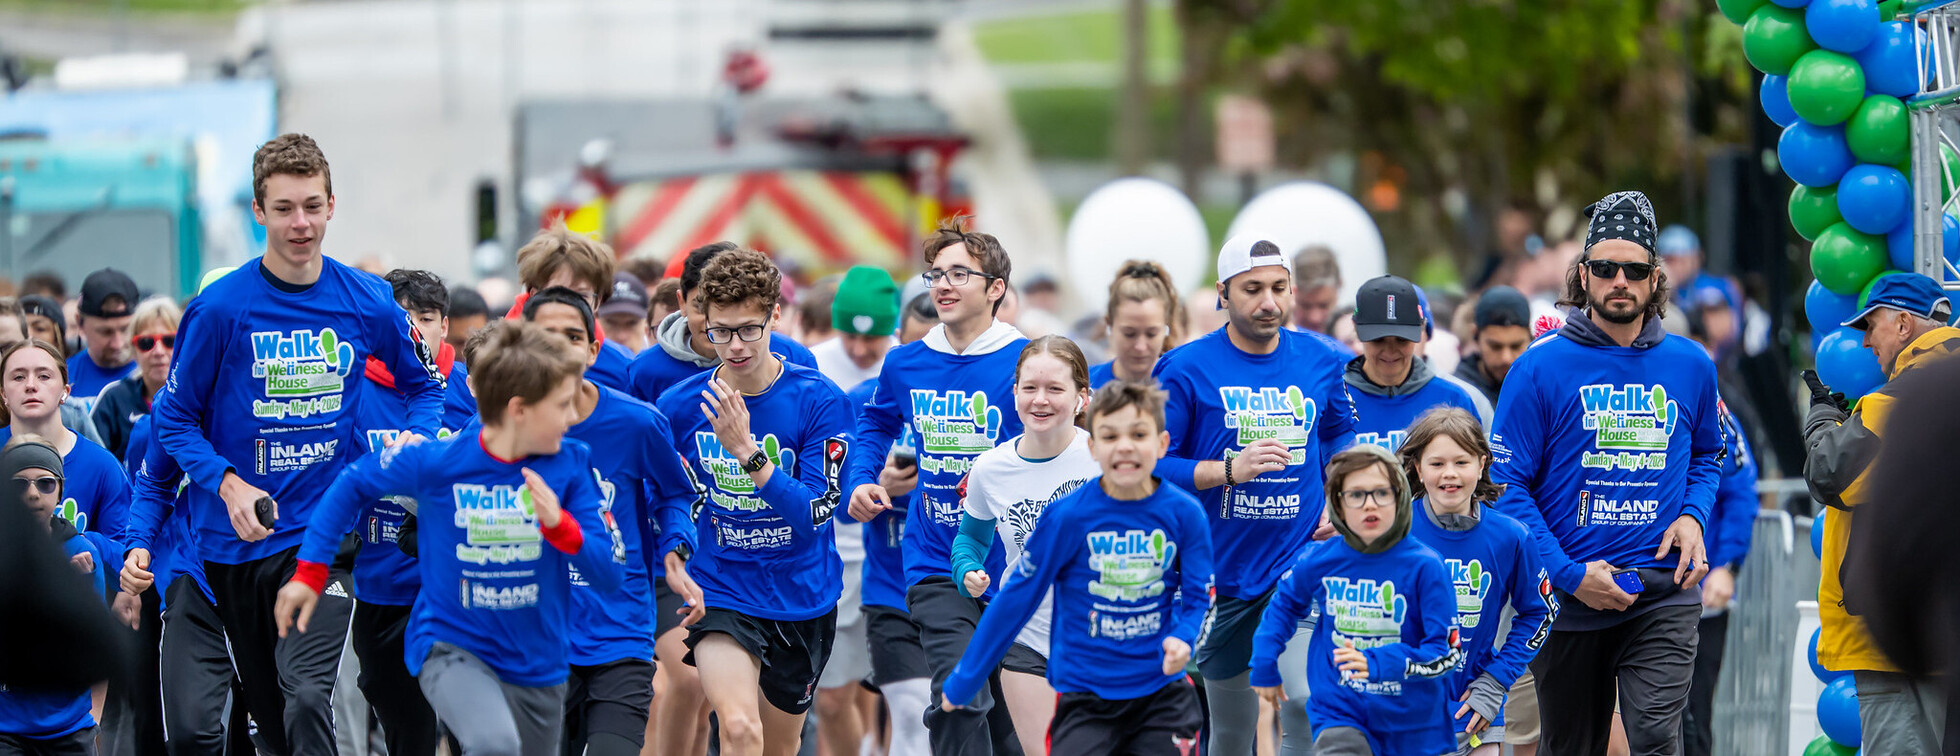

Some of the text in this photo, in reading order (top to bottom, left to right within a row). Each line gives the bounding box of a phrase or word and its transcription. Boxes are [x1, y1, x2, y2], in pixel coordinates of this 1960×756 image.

[252, 331, 321, 361] Walk
[254, 361, 325, 376] for Wellness
[268, 376, 308, 389] House
[911, 391, 973, 418] Walk
[1222, 388, 1289, 412] Walk
[1582, 386, 1652, 412] Walk
[255, 396, 341, 418] Sunday May 4 2025
[922, 420, 974, 434] Wellness
[1226, 413, 1293, 427] for Wellness
[1585, 413, 1655, 429] for Wellness
[925, 434, 960, 446] House
[1240, 427, 1278, 440] House
[1599, 429, 1638, 441] House
[270, 439, 339, 459] INLAND
[270, 457, 300, 467] REAL
[920, 455, 968, 475] nday May 4
[1583, 453, 1665, 470] Sunday May 4 2025
[716, 473, 753, 487] House
[457, 488, 518, 510] Walk
[711, 492, 766, 511] unday May 4
[1234, 494, 1300, 508] INLAND
[1593, 499, 1659, 512] INLAND
[1233, 506, 1300, 516] REAL ESTATE
[1591, 512, 1618, 521] REAL
[722, 526, 792, 540] INLAND
[750, 534, 792, 545] ESTATE
[1090, 534, 1150, 555] Walk
[325, 590, 348, 598] adidas
[1325, 579, 1380, 605] Walk
[1336, 616, 1368, 629] House
